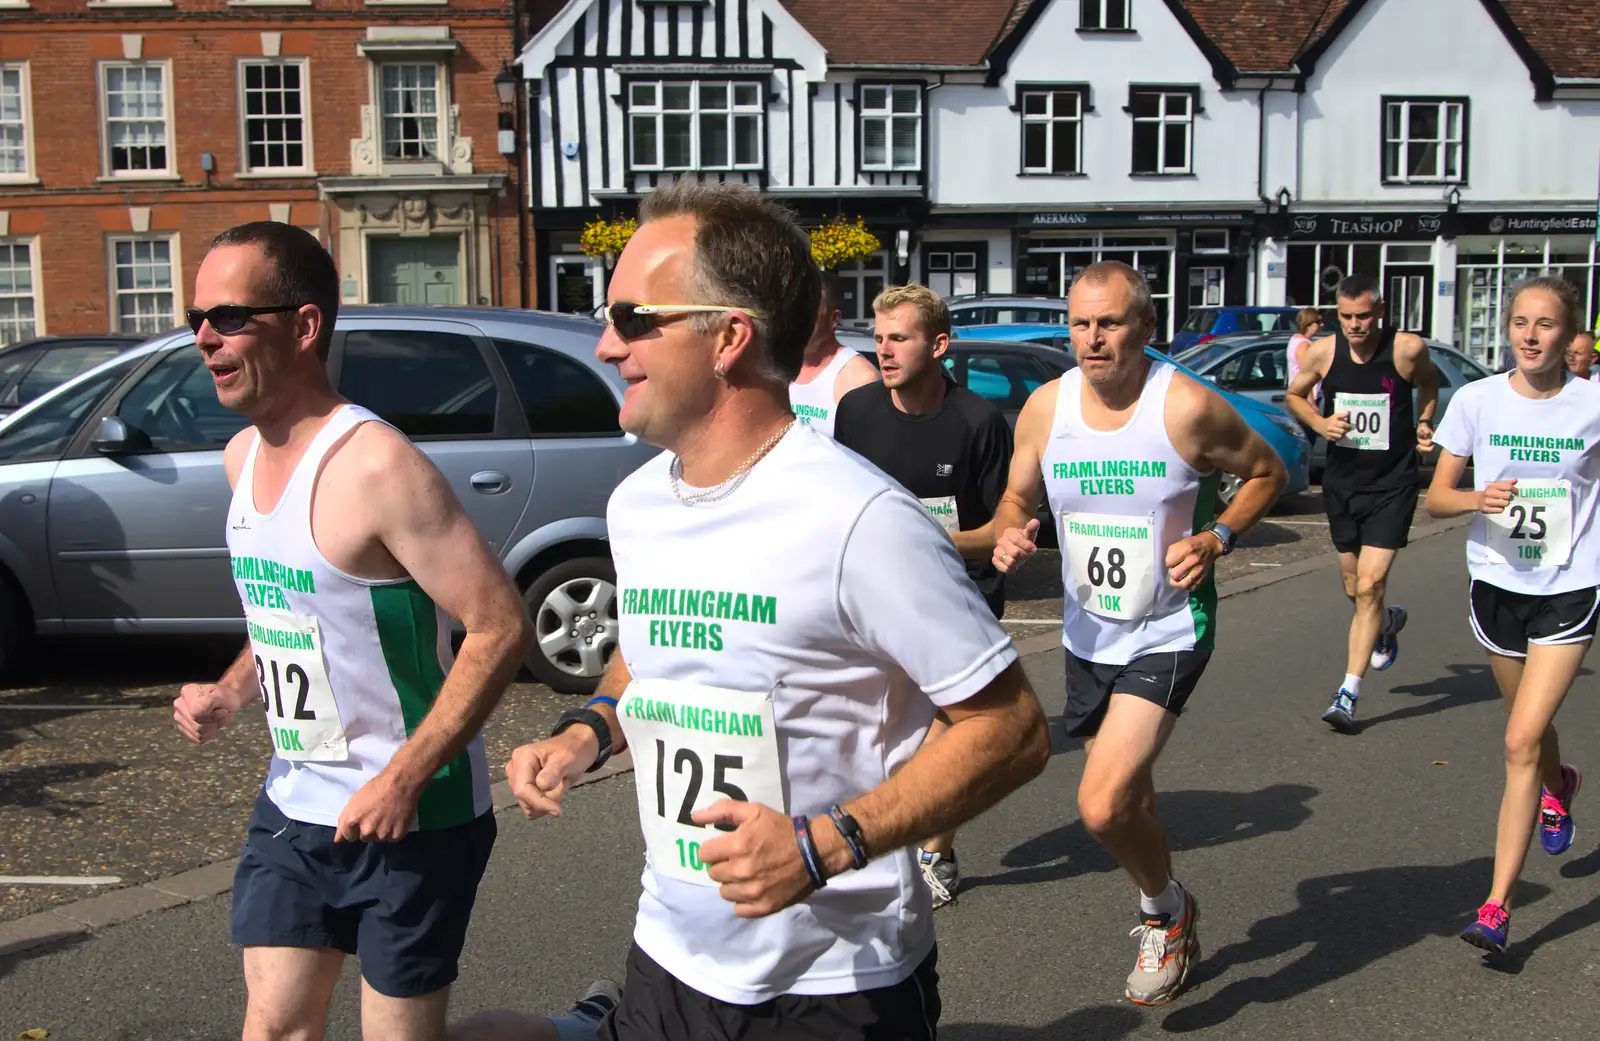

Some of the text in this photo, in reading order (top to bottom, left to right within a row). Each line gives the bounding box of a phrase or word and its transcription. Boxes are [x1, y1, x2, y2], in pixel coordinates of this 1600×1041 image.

[1032, 213, 1088, 224] AKERMANS
[1330, 218, 1403, 234] TEASHOP
[1489, 434, 1585, 450] FRAMLINGHAM
[1510, 448, 1561, 463] FLYERS
[1053, 460, 1166, 479] FRAMLINGHAM
[1080, 478, 1135, 495] FLYERS
[1517, 487, 1567, 499] LINGHAM
[1069, 521, 1148, 540] FRAMLINGHAM
[1509, 505, 1547, 540] 25
[1517, 545, 1542, 559] 10K
[1087, 546, 1127, 589] 68
[622, 588, 777, 625] FRAMLINGHAM
[1097, 594, 1122, 612] 10K
[649, 619, 724, 651] FLYERS
[255, 654, 317, 720] 312
[625, 697, 763, 737] FRAMLINGHAM
[273, 727, 305, 751] 10K
[655, 738, 749, 832] 125
[676, 838, 711, 873] 10
